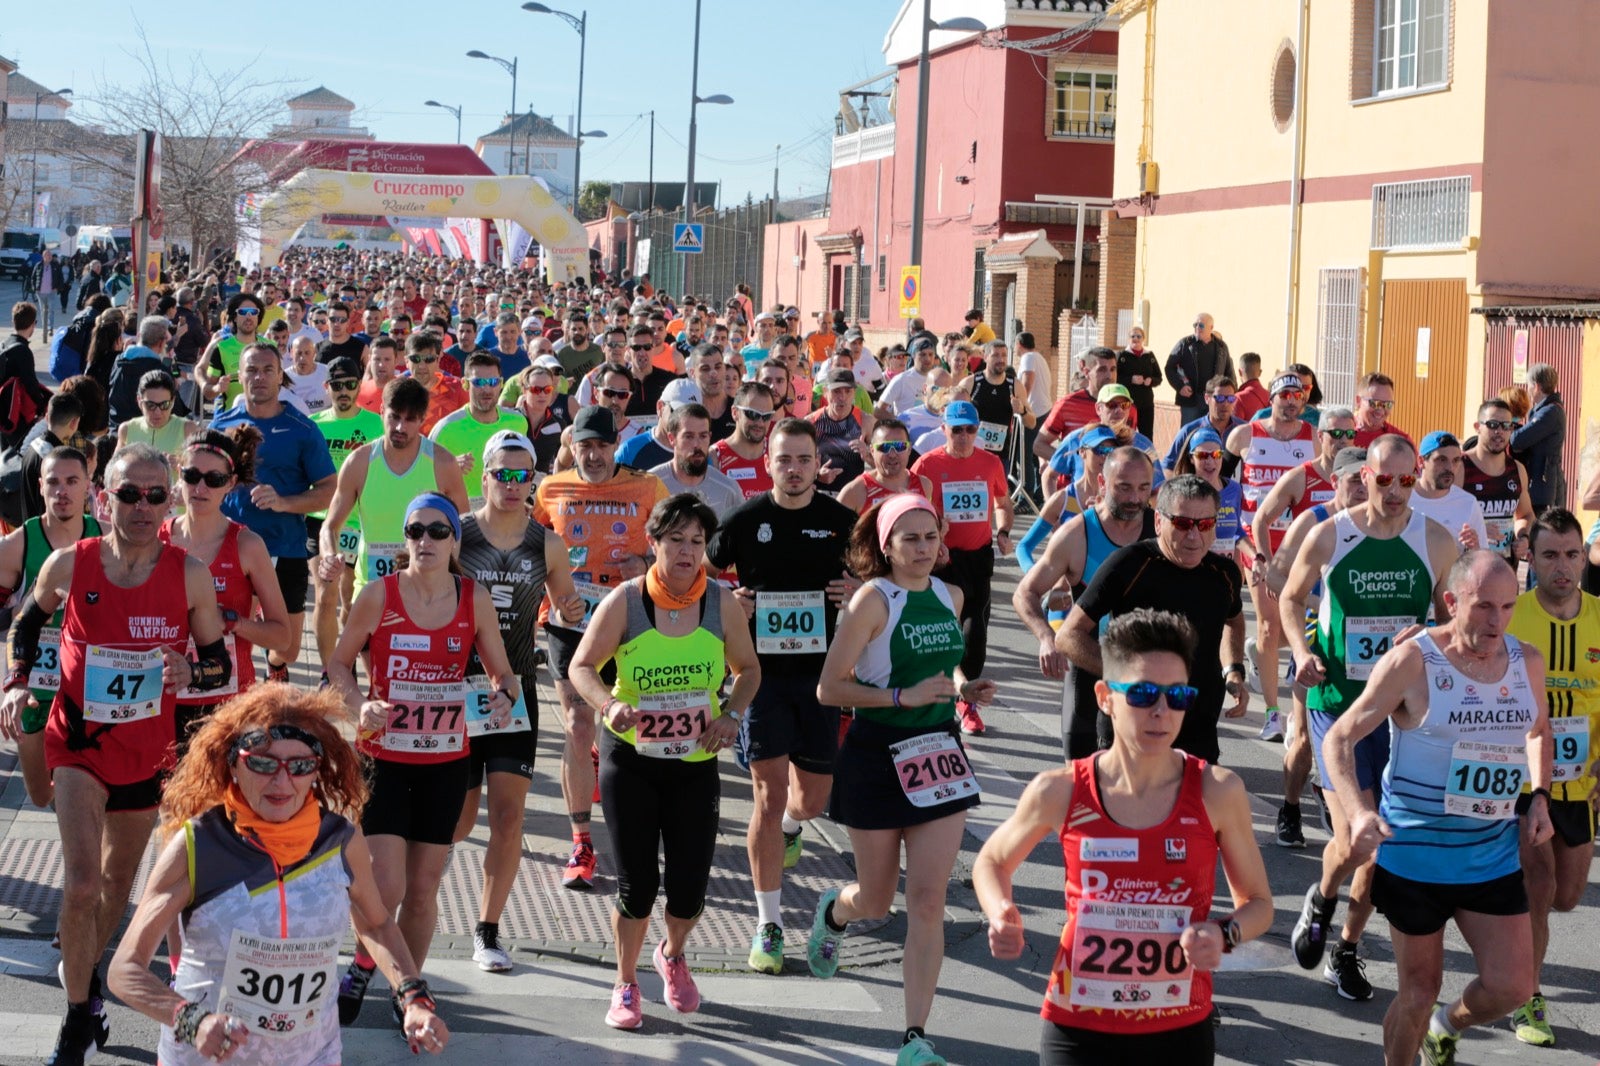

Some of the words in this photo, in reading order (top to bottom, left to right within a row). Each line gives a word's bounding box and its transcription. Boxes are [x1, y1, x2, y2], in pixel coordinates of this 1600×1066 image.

[372, 150, 424, 162] Diputación
[371, 162, 382, 172] de
[384, 163, 424, 174] Granada
[374, 180, 464, 198] Cruzcampo
[382, 199, 426, 212] Radler
[951, 494, 982, 510] 293
[1349, 569, 1406, 584] DEPORTES
[1354, 579, 1396, 594] DELFOS
[129, 616, 166, 626] RUNNING
[768, 611, 814, 634] 940
[901, 622, 954, 640] DEPORTES
[910, 633, 950, 650] DELFOS
[120, 652, 140, 661] PREMIO
[112, 660, 143, 670] DIPUTACIÓN
[633, 664, 702, 682] DEPORTES
[107, 674, 145, 700] 47
[639, 676, 690, 691] DELFOS
[391, 704, 462, 731] 2177
[641, 710, 708, 739] 2231
[1448, 709, 1532, 725] MARACENA
[902, 754, 966, 789] 2108
[1455, 765, 1522, 796] 1083
[1106, 906, 1125, 916] GRAN
[1127, 908, 1155, 918] PREMIO
[1156, 909, 1165, 918] DE
[261, 942, 280, 952] GRAN
[282, 942, 307, 953] PREMIO
[308, 942, 316, 951] DE
[1079, 935, 1188, 976] 2290
[237, 968, 326, 1004] 3012
